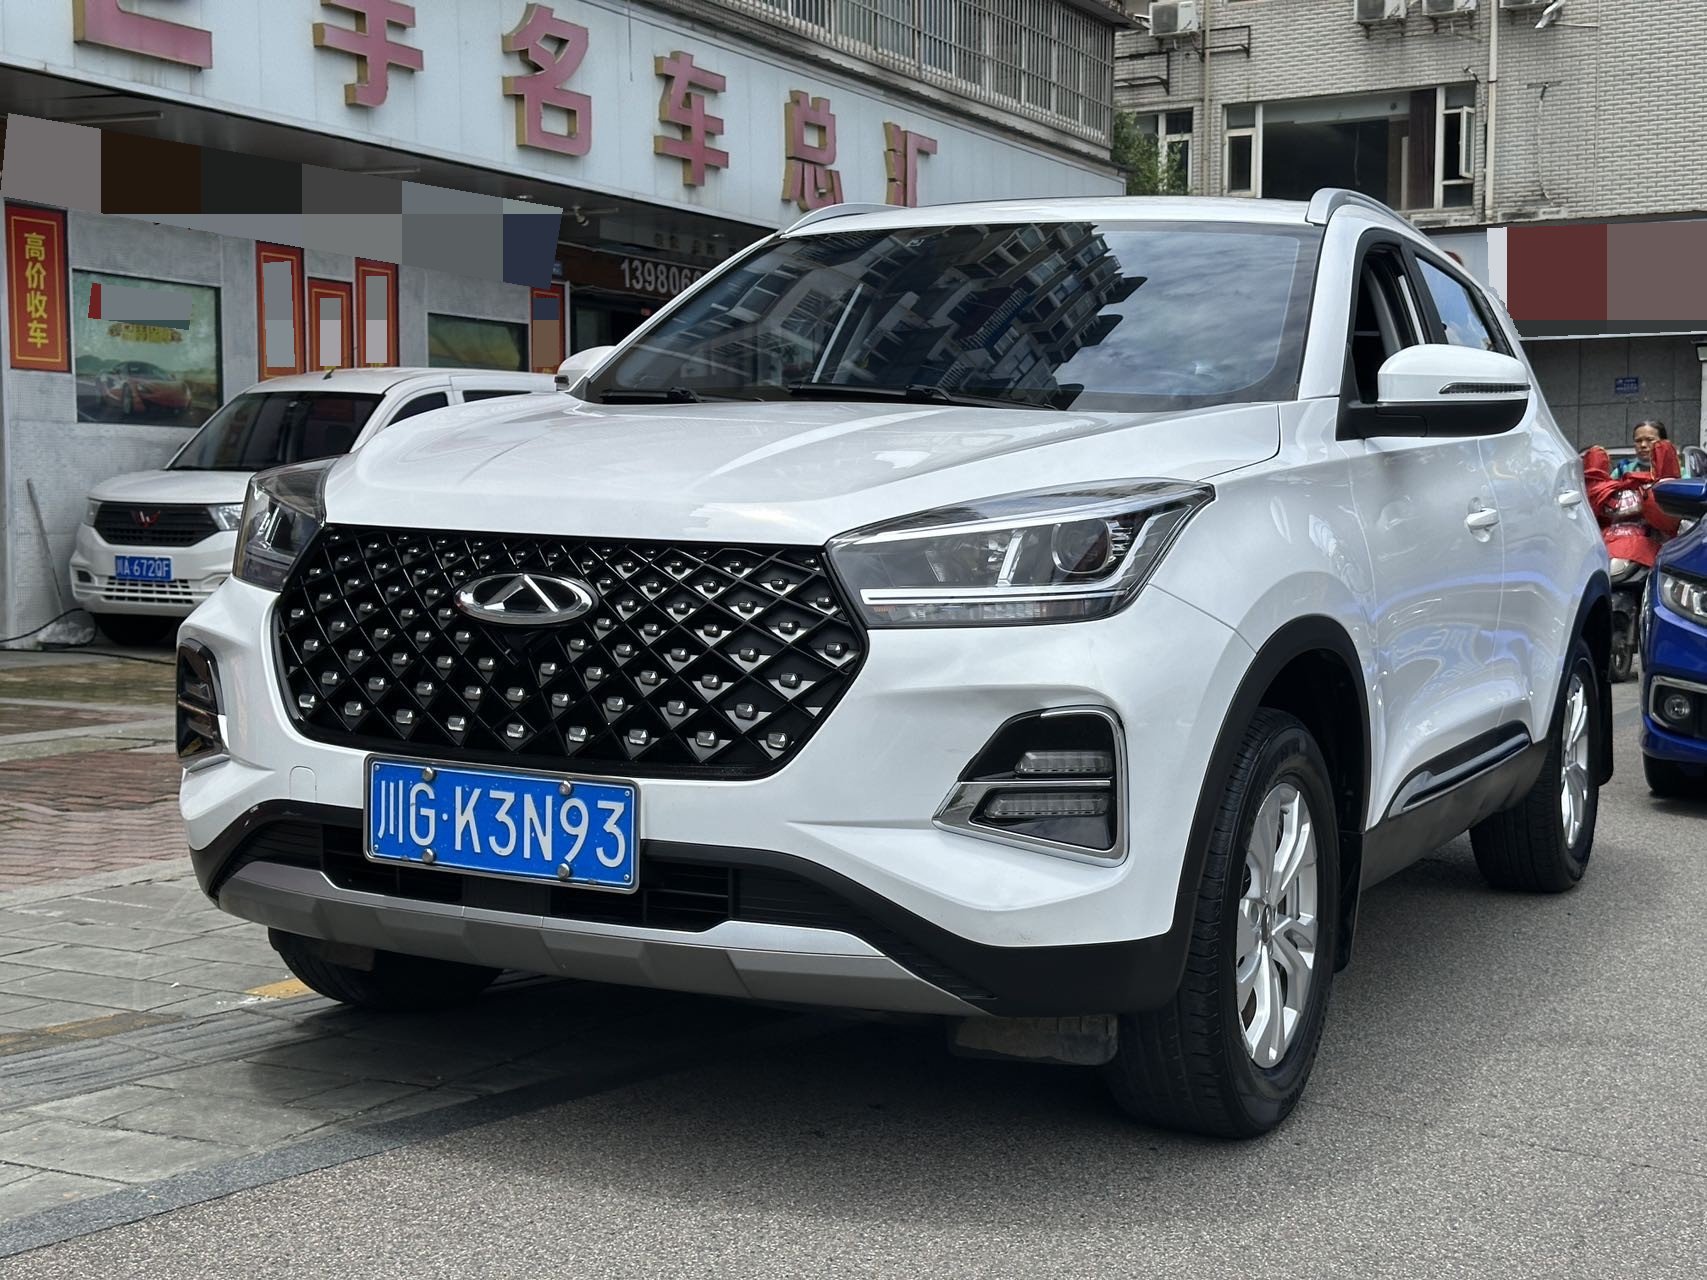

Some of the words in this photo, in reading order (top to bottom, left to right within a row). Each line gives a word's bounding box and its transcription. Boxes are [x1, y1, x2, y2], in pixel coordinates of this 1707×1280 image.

[73, 0, 938, 208] 手名车总汇
[24, 232, 49, 349] 高价收车
[620, 258, 703, 296] 139806
[377, 779, 627, 868] 川G·K3N93
